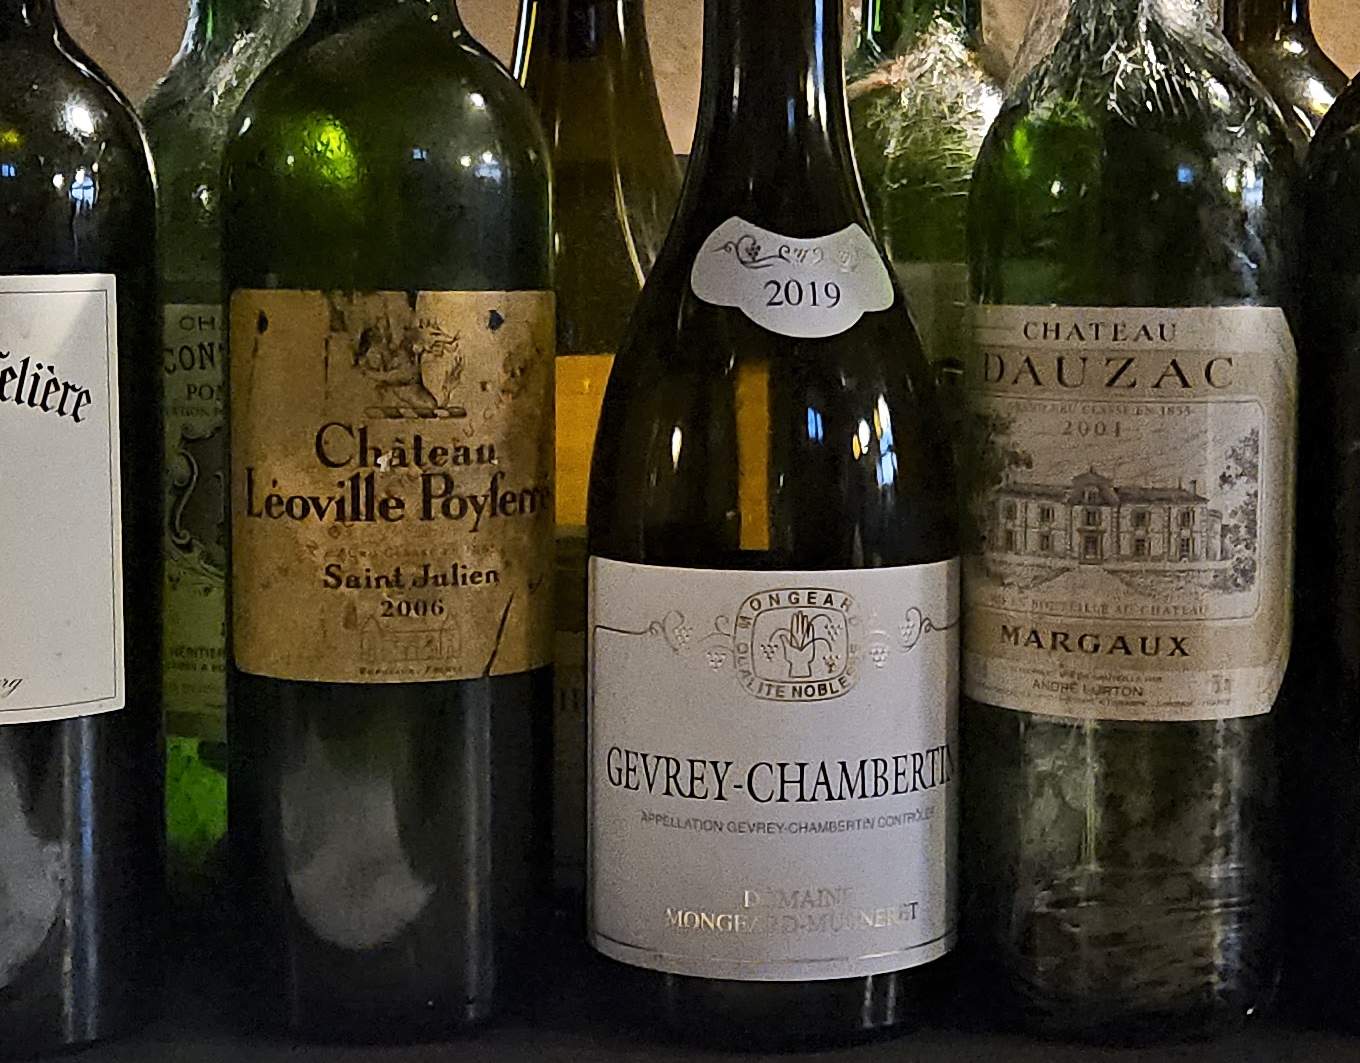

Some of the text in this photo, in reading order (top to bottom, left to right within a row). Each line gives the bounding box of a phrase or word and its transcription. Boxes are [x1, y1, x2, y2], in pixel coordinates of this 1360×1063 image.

[765, 279, 841, 308] 2019
[1023, 320, 1177, 343] CHATEAU
[983, 352, 1234, 389] DAUZAC
[315, 422, 496, 469] Château
[244, 467, 406, 523] Léoville
[323, 562, 501, 590] Saint Julien
[381, 599, 445, 618] 2006
[999, 624, 1190, 657] MARGAUX
[641, 810, 724, 833] APPELLATION
[665, 901, 919, 934] MONGEARD-MUNERET
